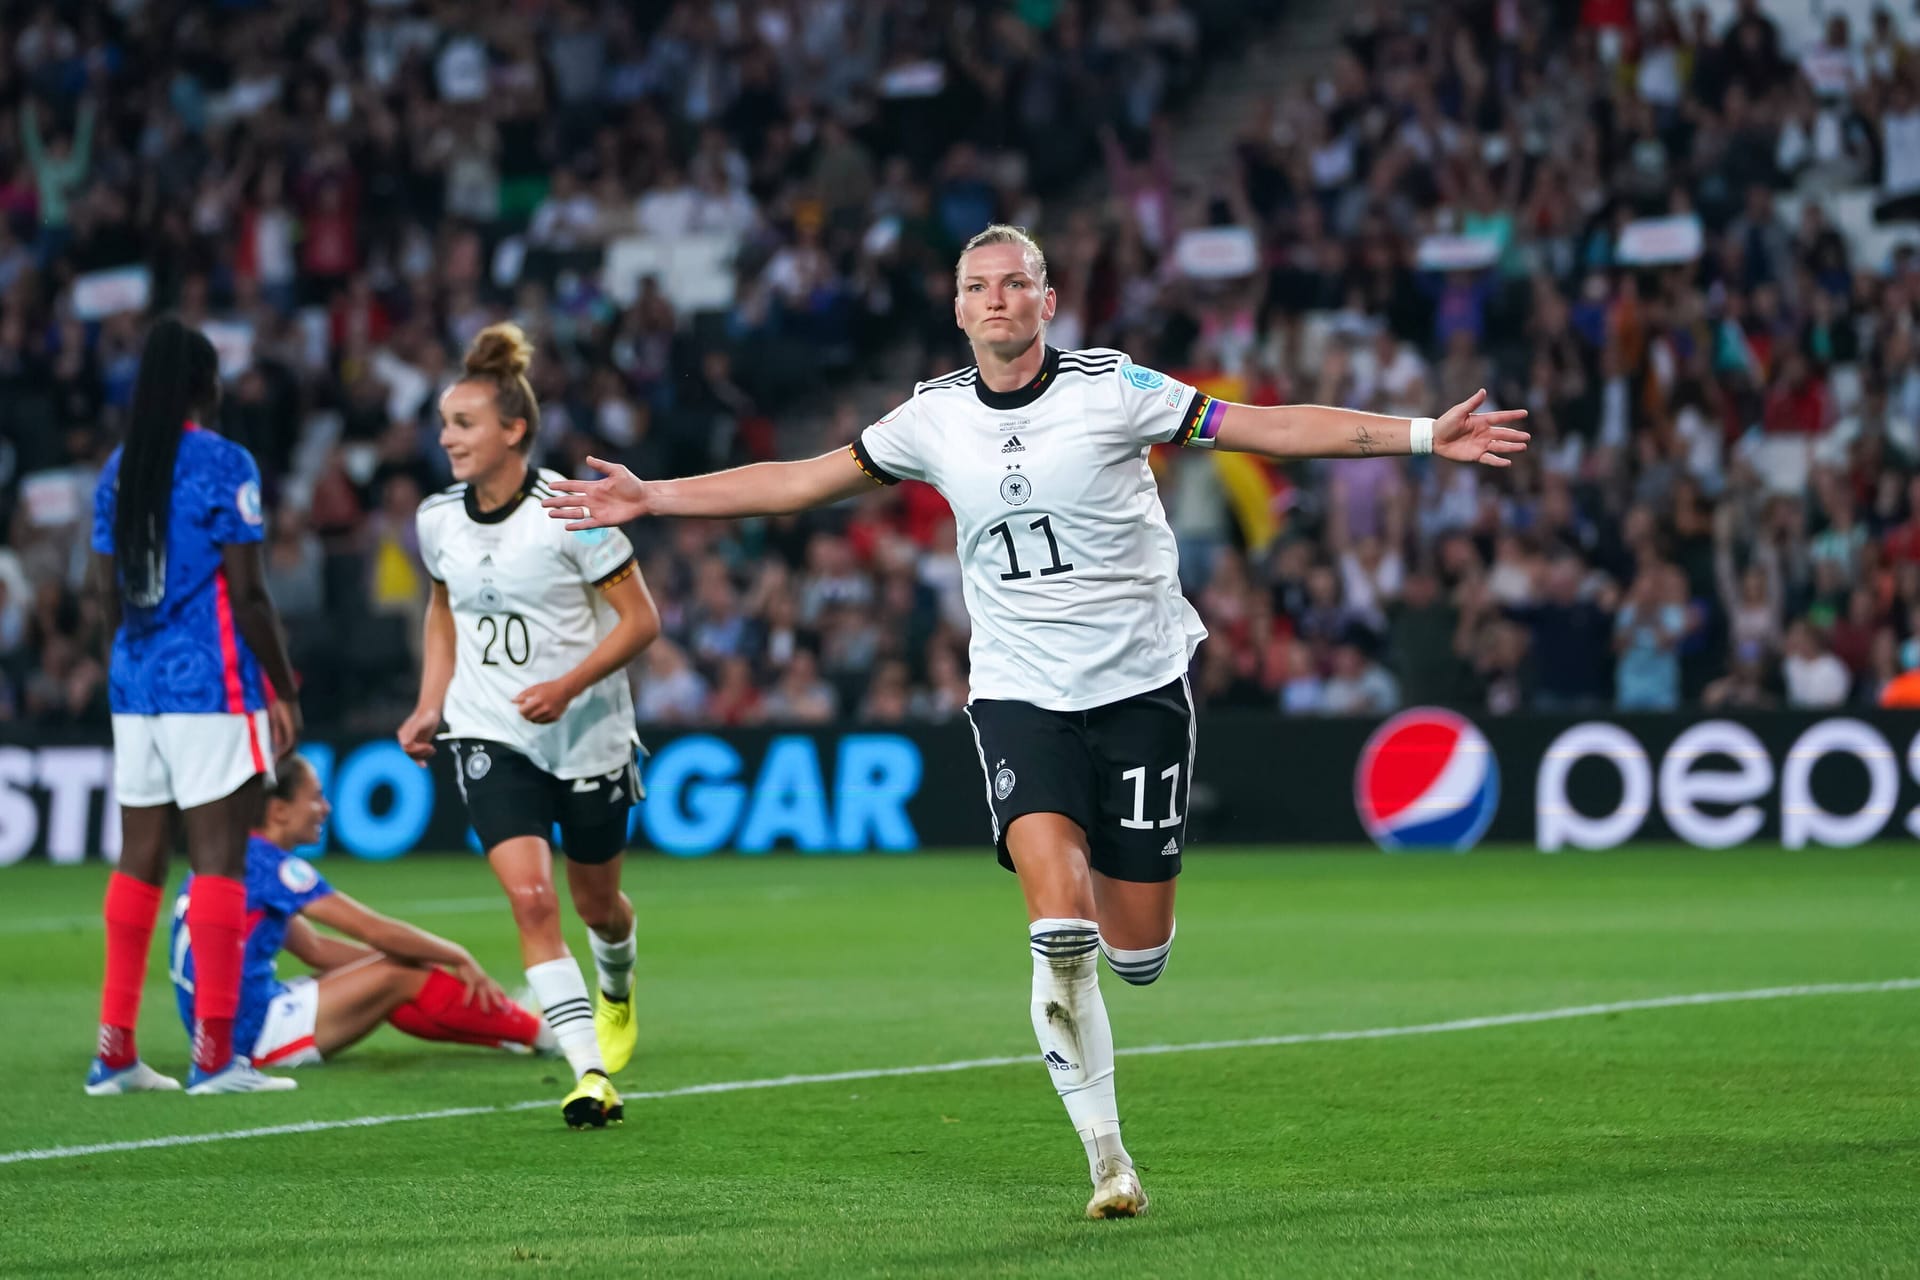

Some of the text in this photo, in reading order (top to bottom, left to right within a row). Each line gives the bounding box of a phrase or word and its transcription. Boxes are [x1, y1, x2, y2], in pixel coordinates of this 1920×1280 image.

[989, 515, 1074, 580] 11
[477, 615, 529, 665] 20
[1120, 763, 1183, 829] 11
